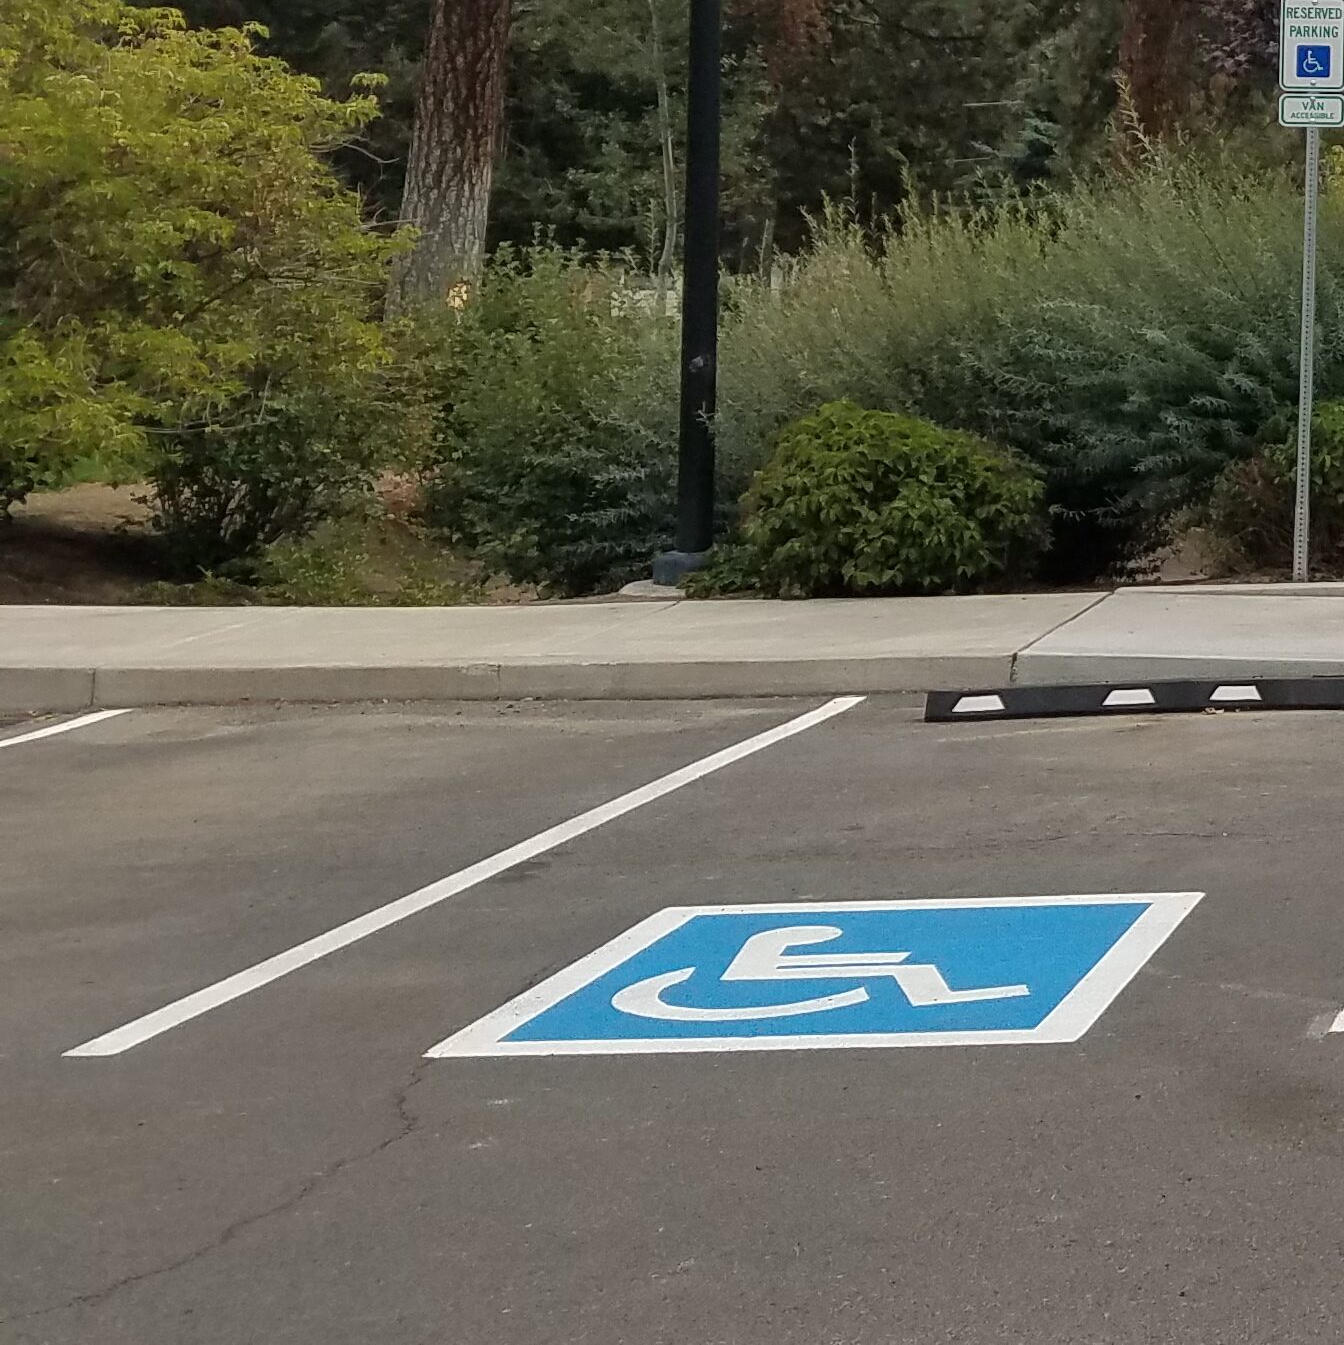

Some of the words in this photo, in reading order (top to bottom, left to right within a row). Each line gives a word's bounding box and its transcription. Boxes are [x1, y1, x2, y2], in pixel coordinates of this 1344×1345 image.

[1286, 7, 1342, 20] RESERVED
[1289, 25, 1339, 38] PARKING
[1301, 101, 1325, 111] VAN
